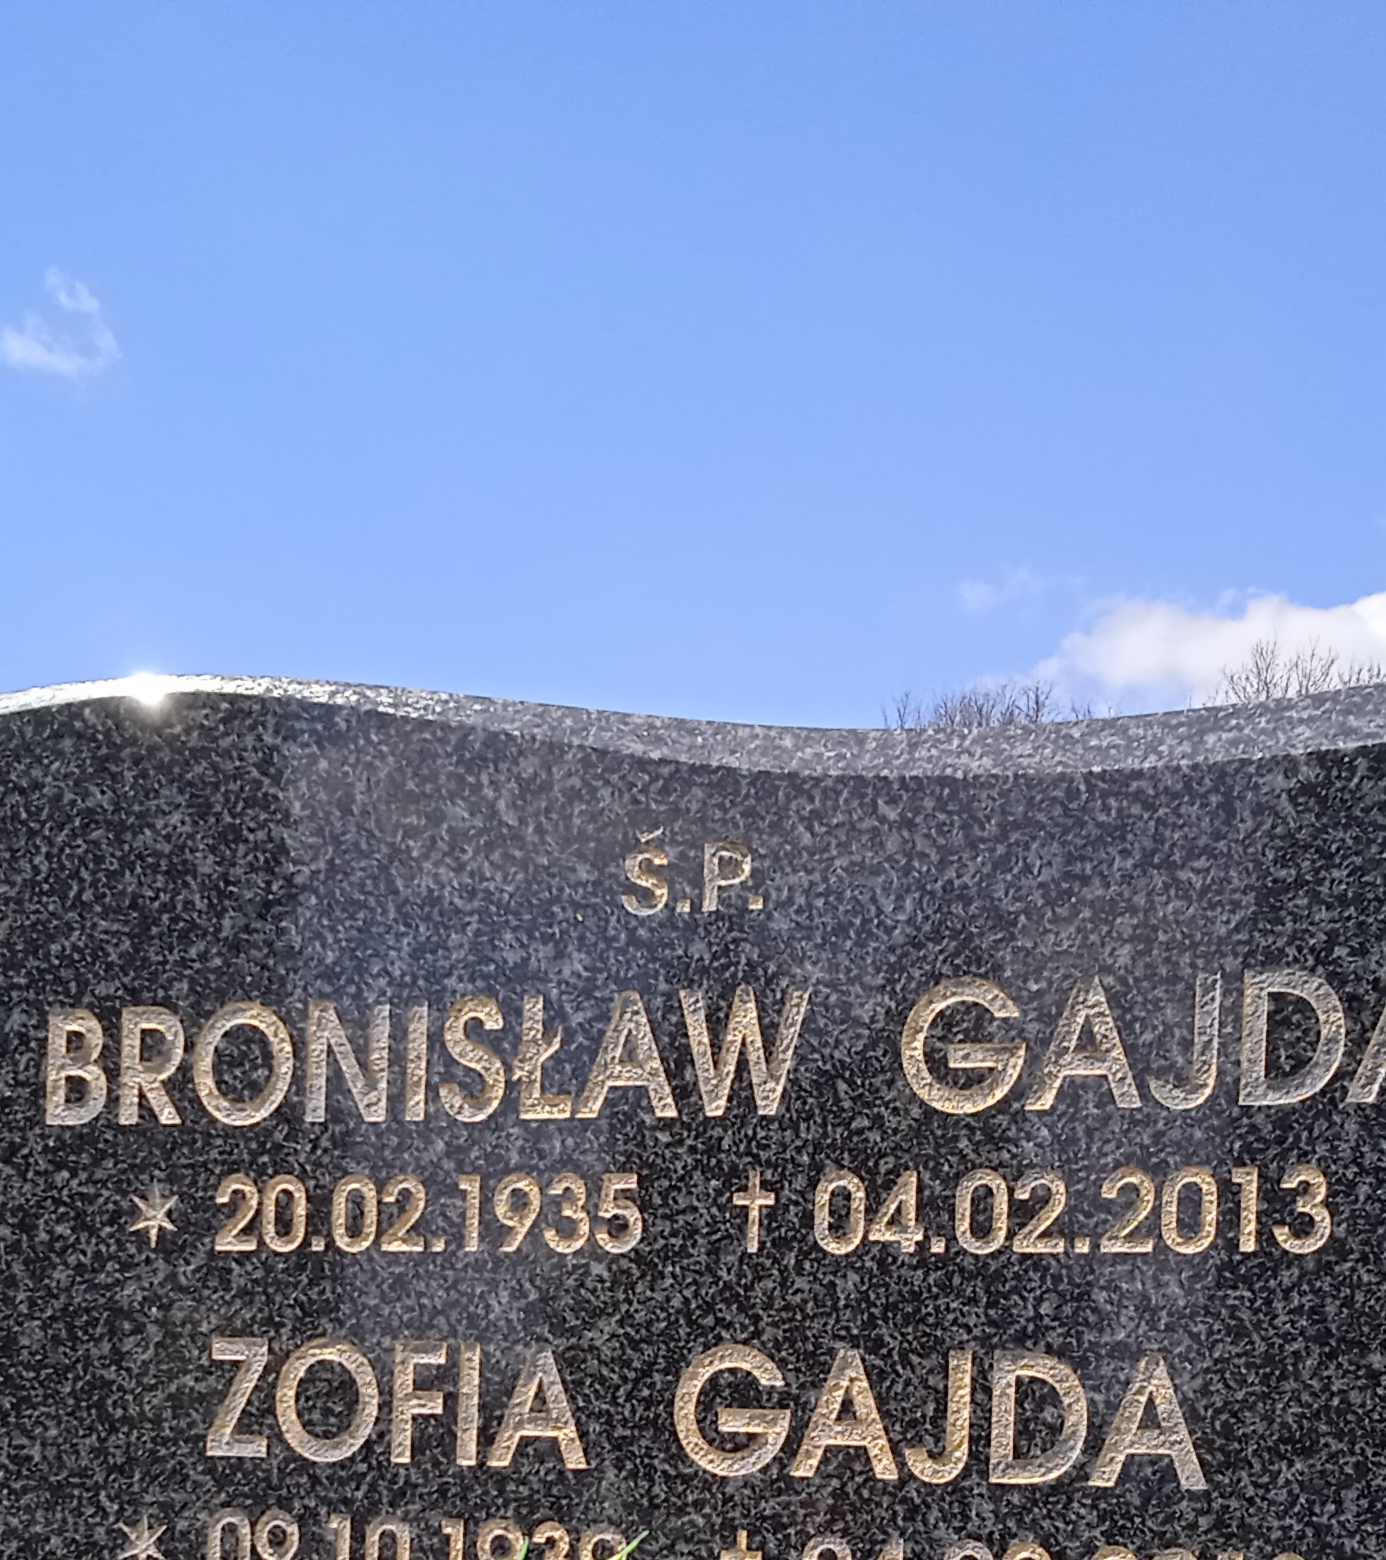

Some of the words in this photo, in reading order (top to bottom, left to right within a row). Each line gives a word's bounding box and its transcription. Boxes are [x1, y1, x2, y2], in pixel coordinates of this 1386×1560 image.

[621, 826, 764, 916] Ś.P.
[44, 988, 810, 1126] BRONISŁAW
[213, 1173, 644, 1254] 20.02.1935
[813, 1163, 1334, 1256] 04.02.2013
[205, 1336, 589, 1470] ZOFIA
[673, 1343, 1209, 1491] GAJDA
